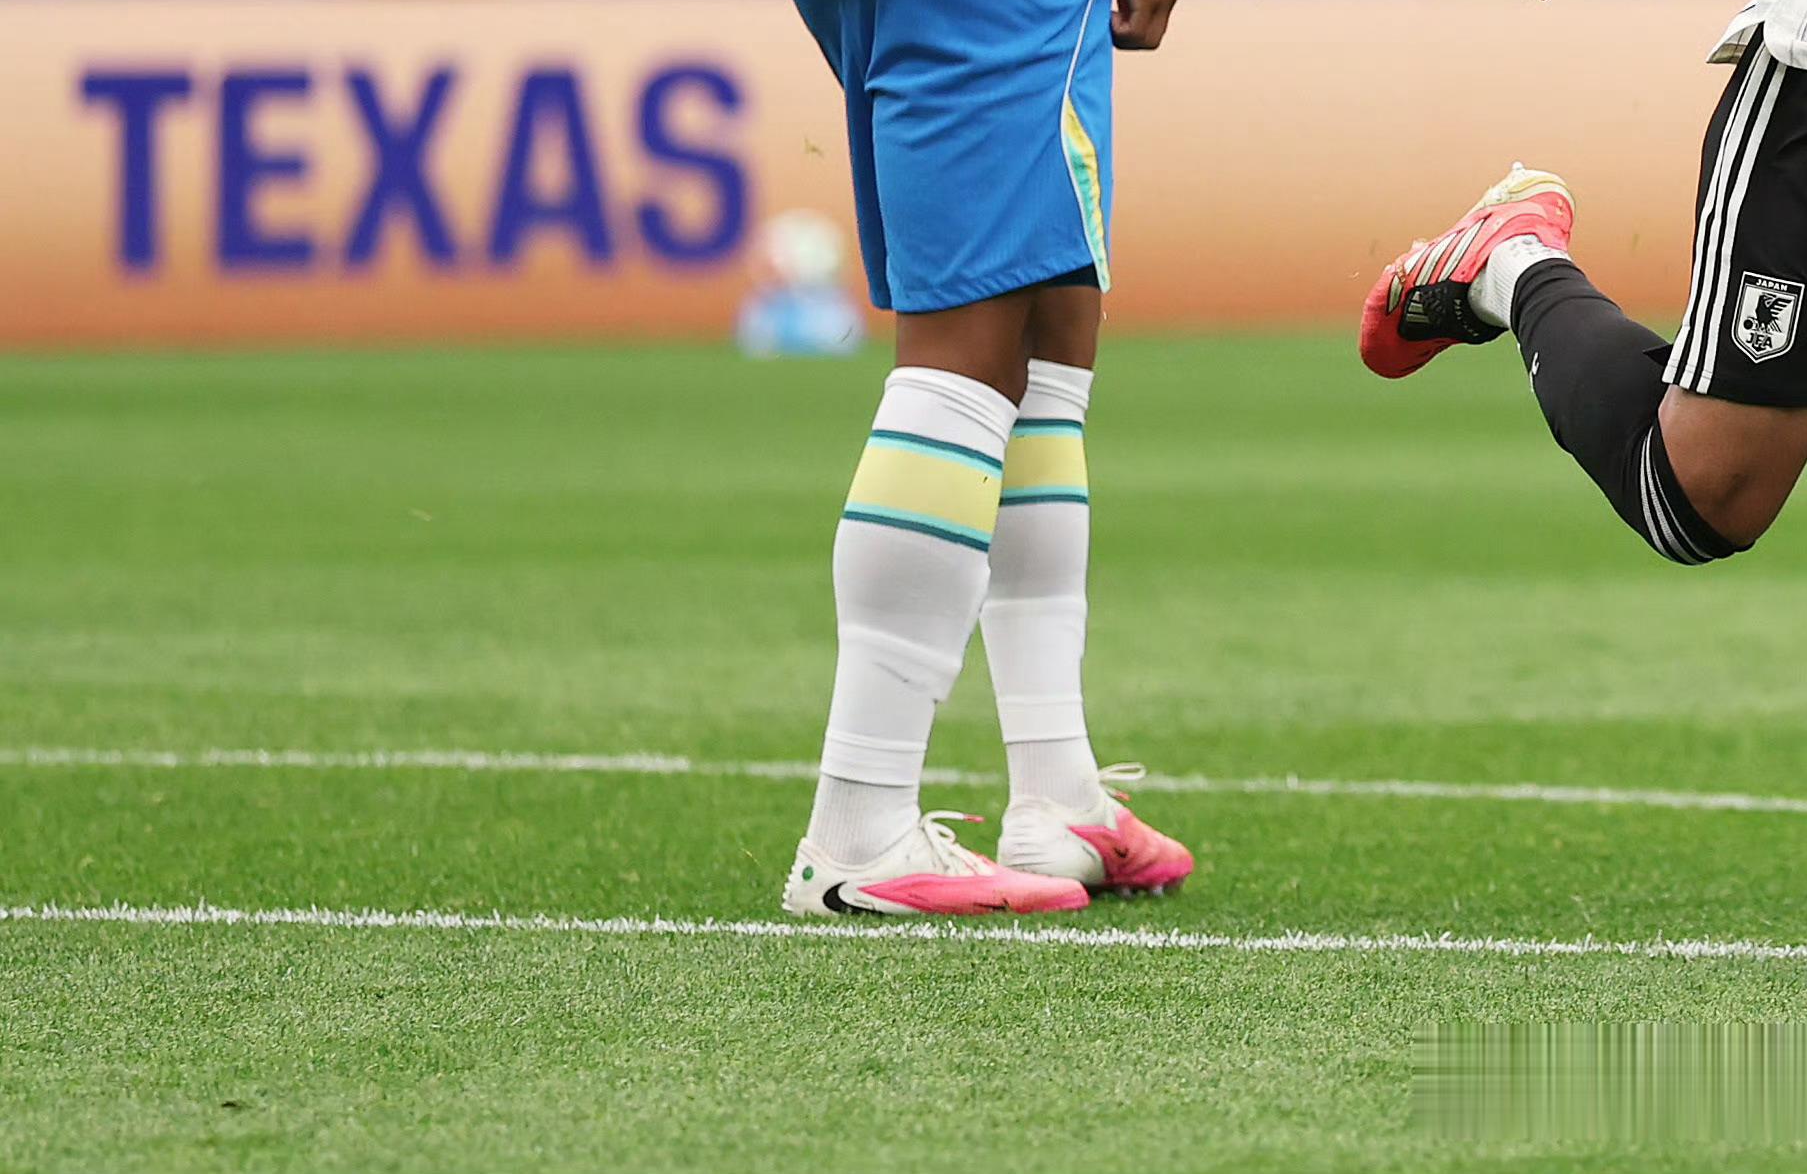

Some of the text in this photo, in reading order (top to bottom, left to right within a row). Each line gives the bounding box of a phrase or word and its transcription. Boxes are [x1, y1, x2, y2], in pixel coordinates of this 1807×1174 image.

[80, 64, 748, 272] TEXAS
[1755, 279, 1788, 292] JAPAN
[1746, 333, 1773, 349] JFA
